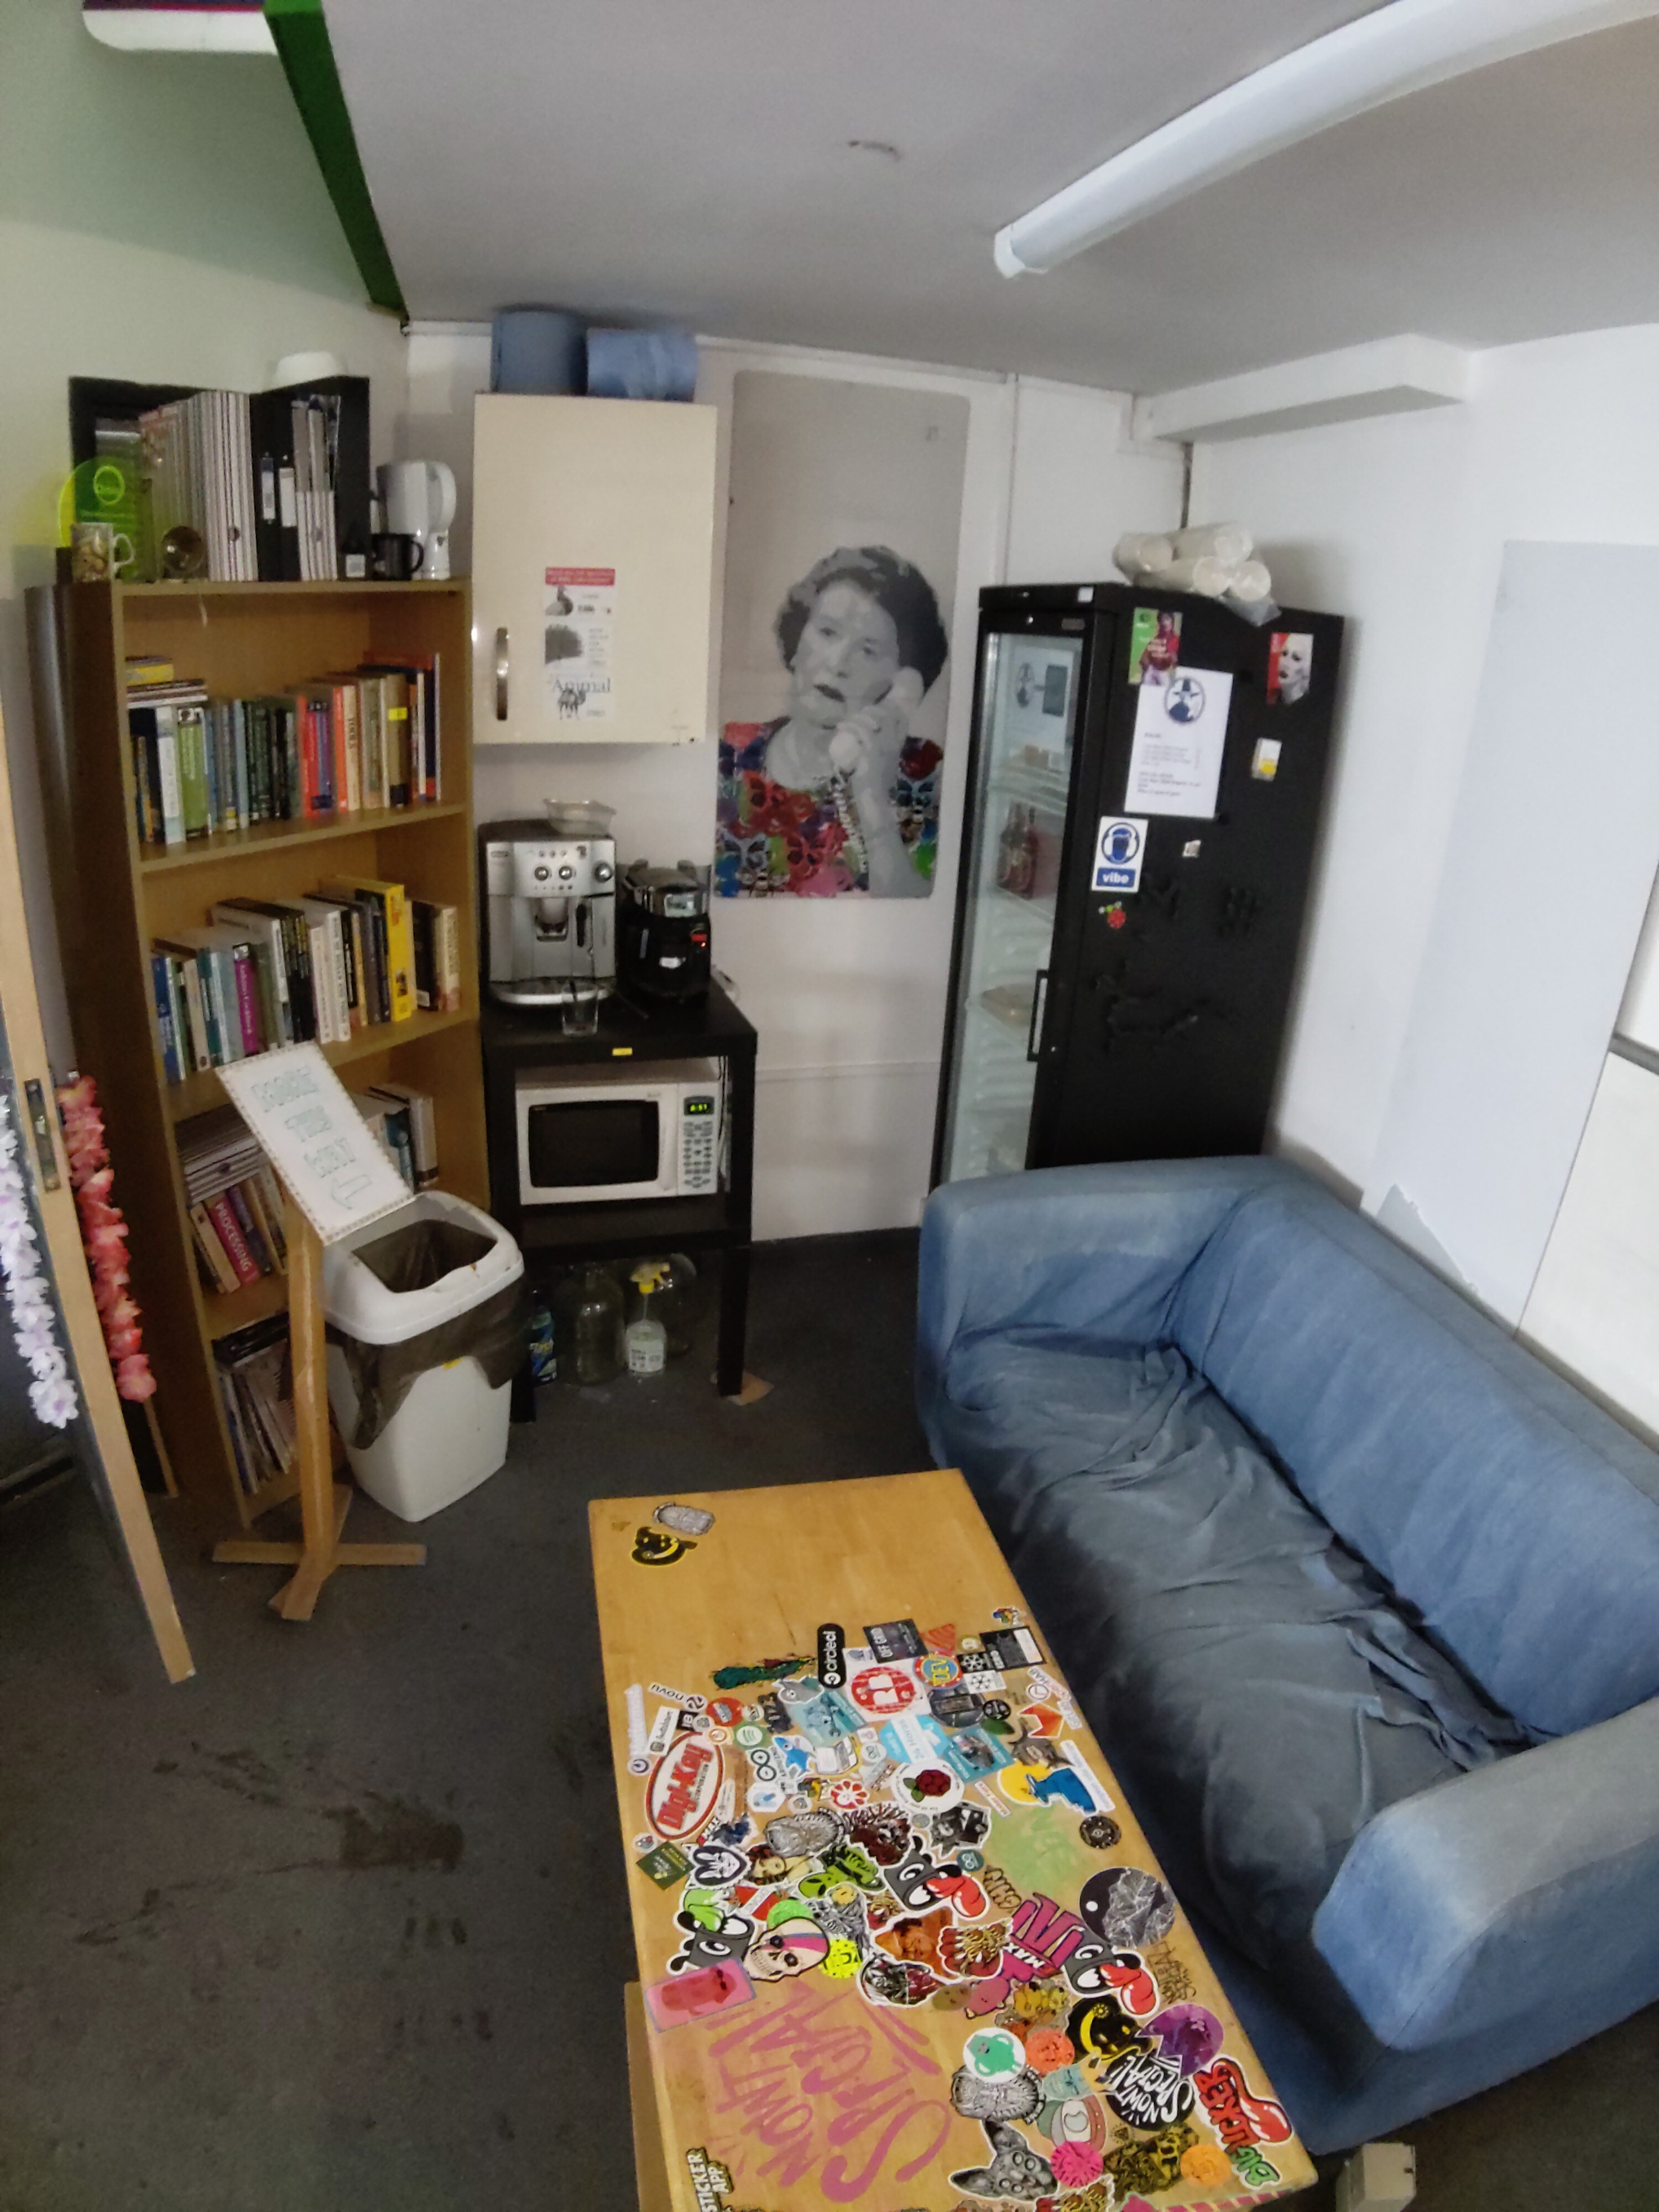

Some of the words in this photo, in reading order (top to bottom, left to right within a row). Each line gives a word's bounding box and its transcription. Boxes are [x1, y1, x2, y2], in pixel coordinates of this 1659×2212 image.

[213, 1201, 252, 1273] PROCESSING
[656, 1743, 713, 1829] Digi-Key
[1003, 1942, 1046, 1969] MAX
[715, 2062, 822, 2188] NOWT
[1114, 2084, 1160, 2124] NOWT
[687, 2153, 718, 2212] STICKER
[708, 2166, 729, 2194] APP
[1230, 2146, 1281, 2187] BIG
